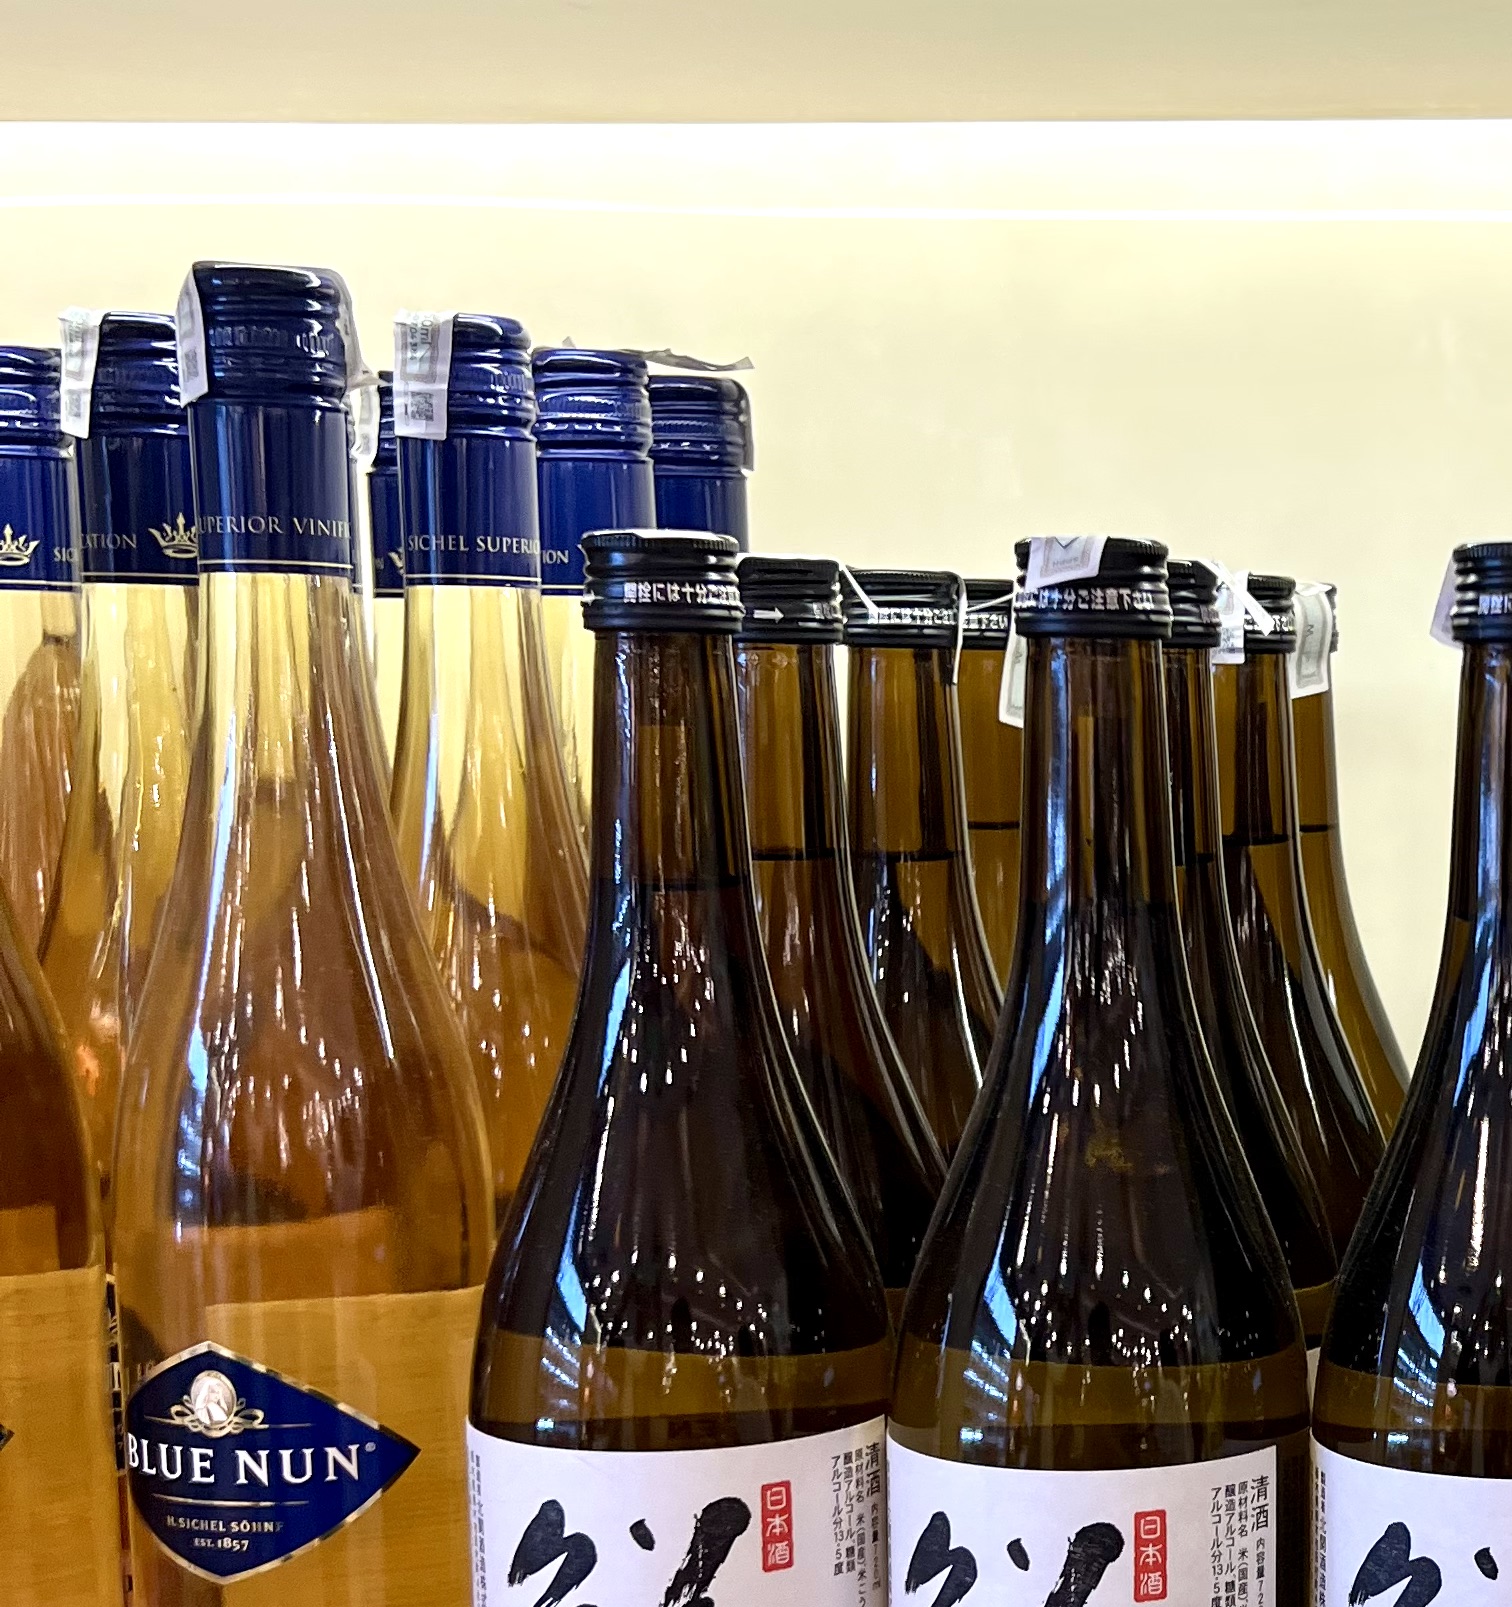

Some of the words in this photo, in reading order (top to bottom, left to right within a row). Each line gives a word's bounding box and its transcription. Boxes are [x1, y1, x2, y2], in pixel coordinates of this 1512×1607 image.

[409, 535, 469, 551] SICHEL
[127, 1433, 214, 1484] BLUE
[235, 1443, 359, 1486] NUN
[764, 1484, 792, 1568] 日本酒
[1250, 1475, 1269, 1532] 清酒
[217, 1537, 249, 1551] 1857
[1137, 1513, 1164, 1598] 日本酒
